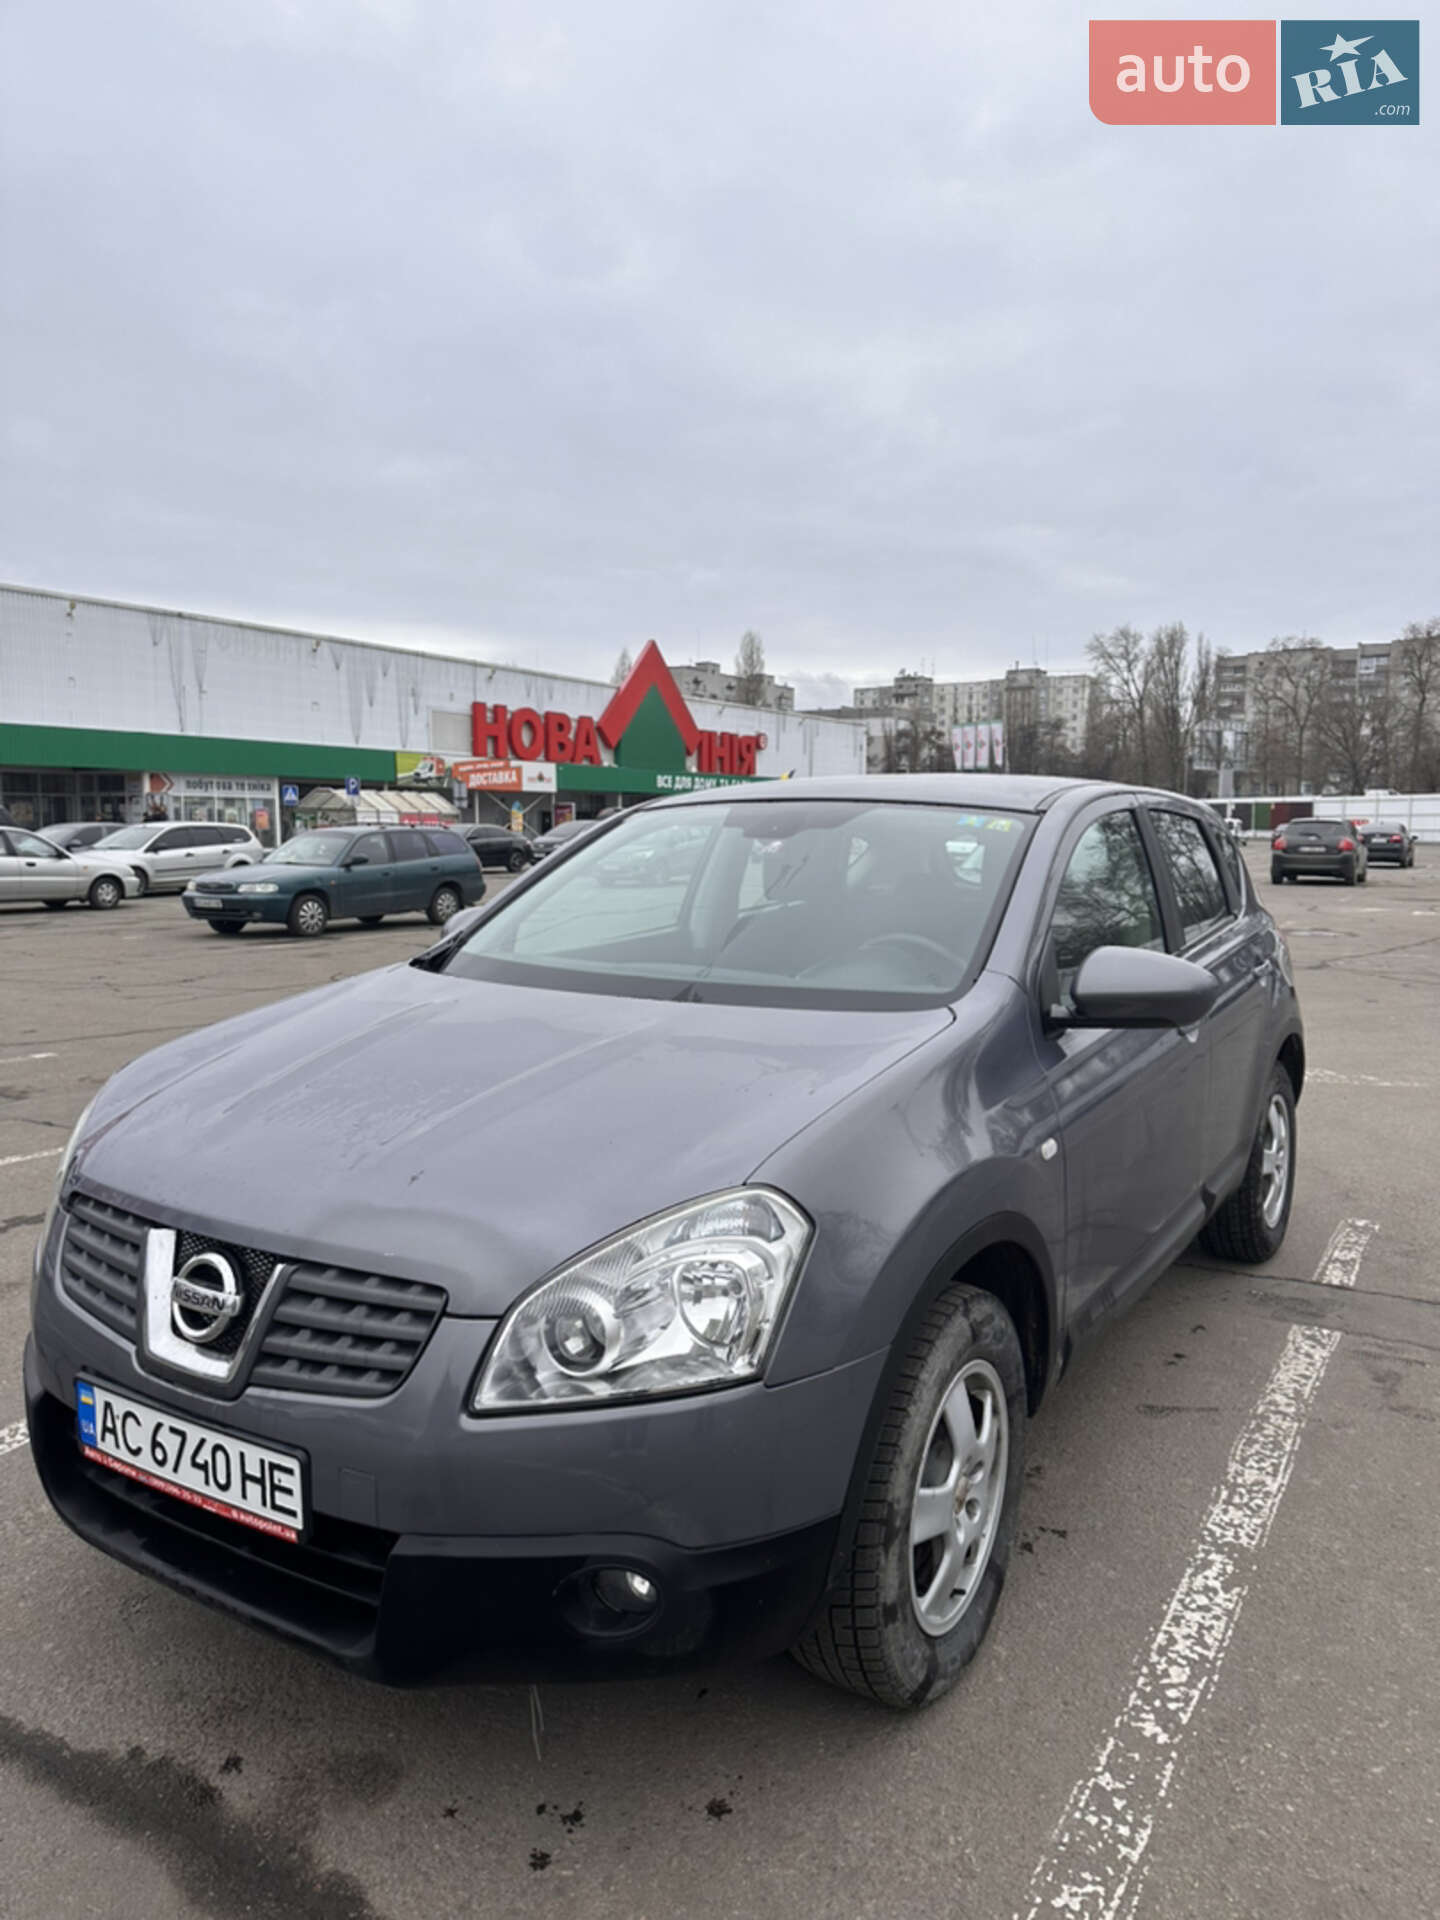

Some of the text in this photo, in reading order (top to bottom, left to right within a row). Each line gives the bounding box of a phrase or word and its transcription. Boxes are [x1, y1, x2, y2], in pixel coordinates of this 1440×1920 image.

[471, 702, 601, 765] НОВА
[468, 769, 518, 788] ДОСТАВКА
[656, 774, 673, 788] ВСЕ
[174, 1287, 225, 1311] ISSAN
[101, 1401, 143, 1457] AC
[150, 1422, 232, 1492] 6740
[240, 1451, 298, 1519] HE
